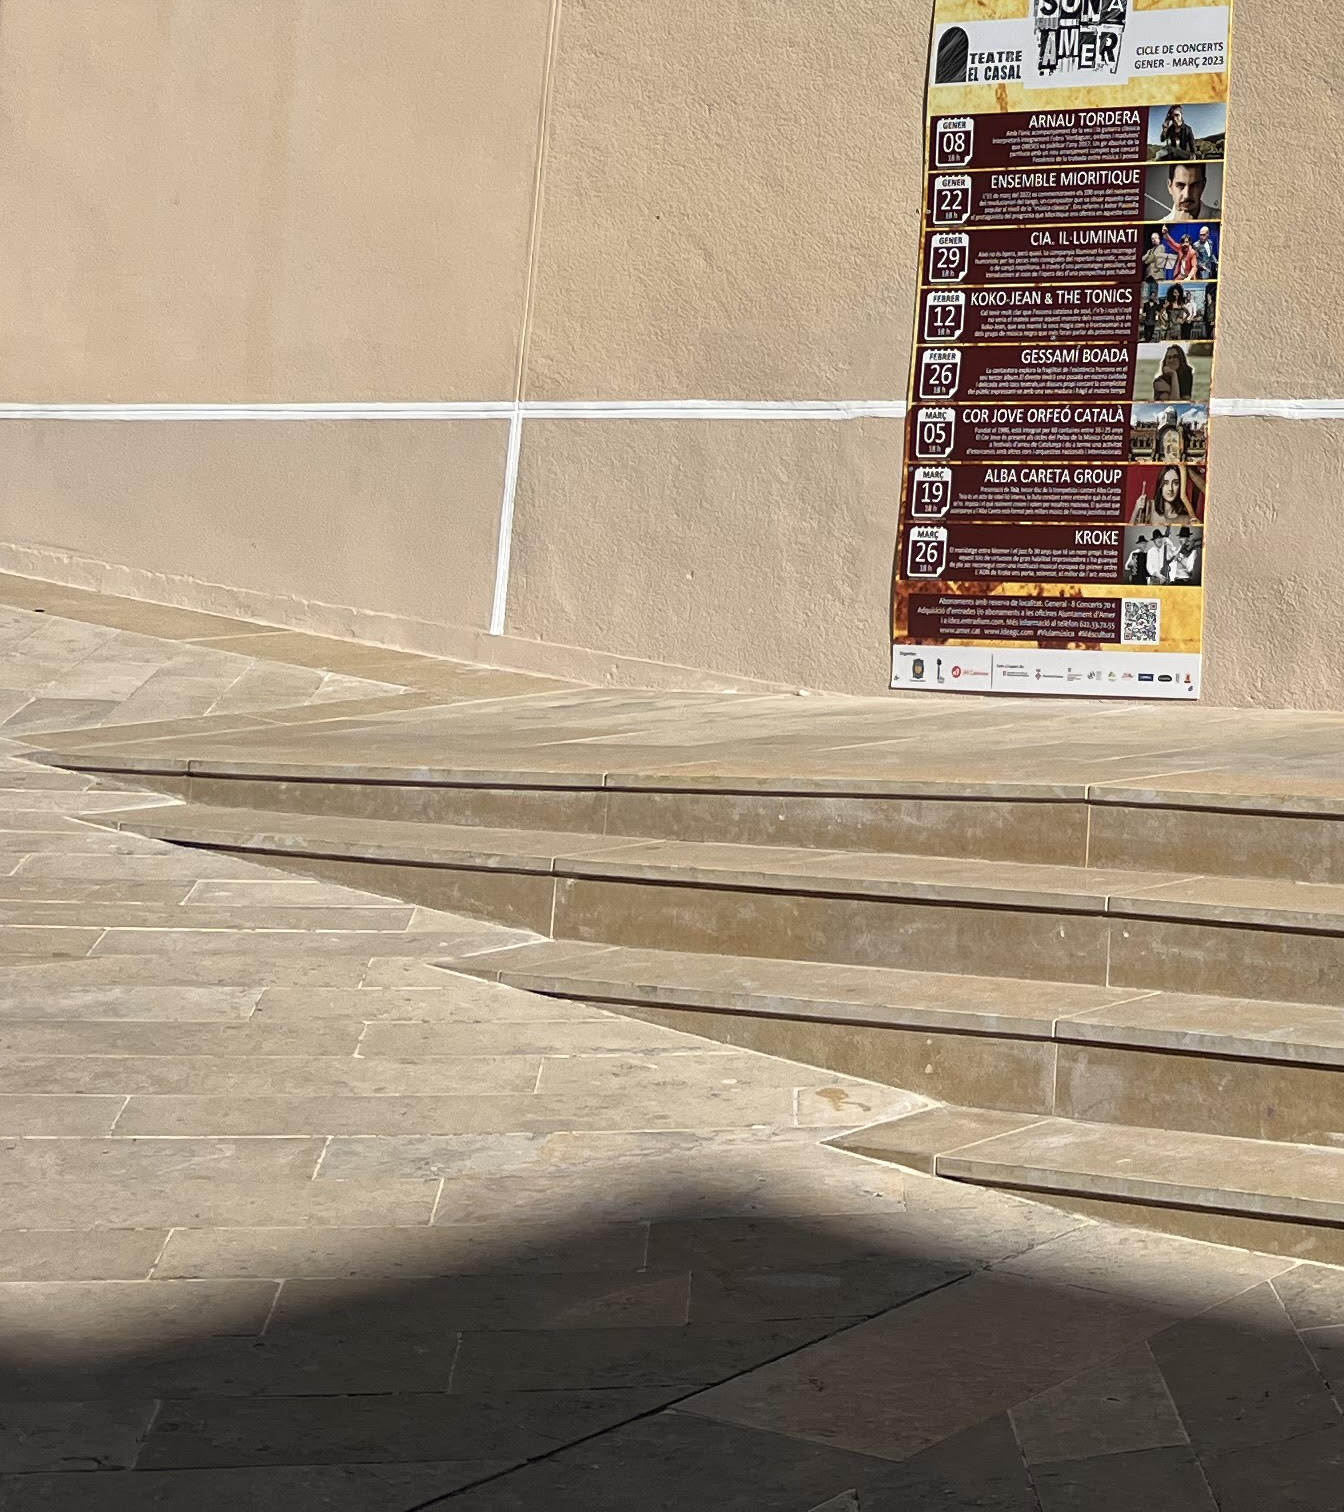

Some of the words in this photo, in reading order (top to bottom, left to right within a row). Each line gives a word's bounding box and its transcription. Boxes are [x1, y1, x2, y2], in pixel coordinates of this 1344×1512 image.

[969, 50, 1022, 64] TEATRE
[1040, 31, 1119, 70] AMER
[1136, 45, 1160, 56] CICLE
[1162, 44, 1174, 55] DE
[1176, 42, 1225, 54] CONCERTS
[1135, 58, 1165, 70] GENER
[1172, 57, 1201, 70] MARÇ
[1202, 55, 1224, 67] 2023
[968, 68, 978, 82] EL
[984, 65, 1022, 81] CASAL
[943, 121, 966, 129] GENER
[1029, 113, 1075, 128] ARNAU
[1078, 111, 1140, 126] TORDERA
[943, 133, 965, 153] 08
[942, 179, 966, 187] GENER
[991, 173, 1057, 188] ENSEMBLE
[1060, 169, 1140, 186] MIORITIQUE
[941, 190, 962, 211] 22
[939, 237, 963, 245] GENER
[1030, 231, 1056, 246] CIA.
[1059, 229, 1138, 245] IL·LUMINATI
[937, 248, 960, 268] 29
[933, 295, 960, 303] FEBRER
[971, 291, 1041, 306] KOKO-JEAN
[1044, 292, 1053, 304] &
[1056, 290, 1082, 304] THE
[1085, 289, 1133, 303] TONICS
[934, 306, 955, 327] 12
[929, 352, 956, 361] FEBRER
[1021, 346, 1080, 364] GESSAMÍ
[1083, 348, 1129, 363] BOADA
[929, 364, 952, 385] 26
[925, 411, 947, 421] MARÇ
[963, 409, 989, 423] COR
[992, 409, 1024, 423] JOVE
[1027, 405, 1071, 423] ORFEÓ
[1075, 405, 1124, 423] CATALÀ
[924, 423, 946, 443] 05
[923, 471, 944, 481] MARÇ
[984, 469, 1017, 483] ALBA
[1020, 469, 1070, 483] CARETA
[1074, 469, 1122, 484] GROUP
[921, 482, 943, 503] 19
[917, 530, 939, 540] MARÇ
[1075, 530, 1119, 545] KROKE
[915, 542, 938, 563] 26
